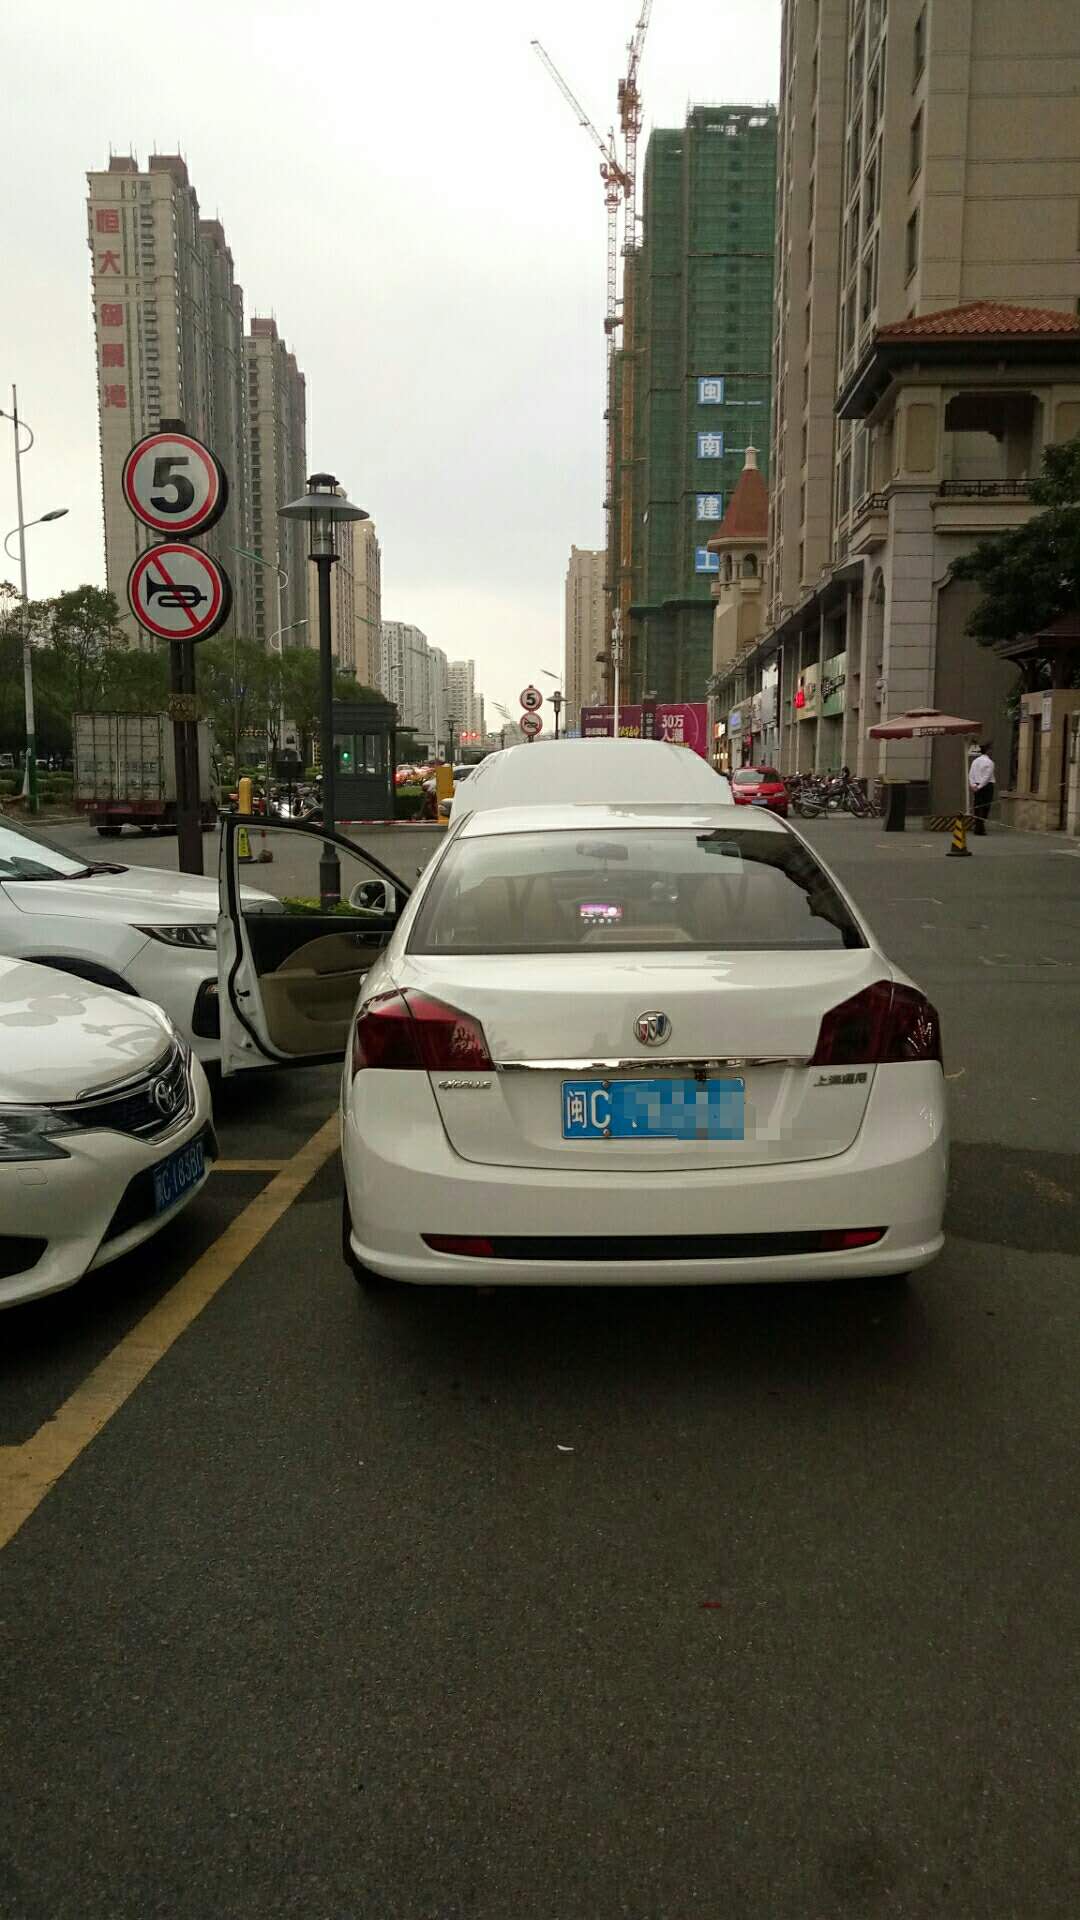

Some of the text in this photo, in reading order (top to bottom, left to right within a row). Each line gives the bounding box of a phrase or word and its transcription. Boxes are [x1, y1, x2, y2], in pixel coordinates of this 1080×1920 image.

[150, 456, 195, 513] 5
[526, 693, 536, 706] 5
[661, 714, 685, 728] 30万
